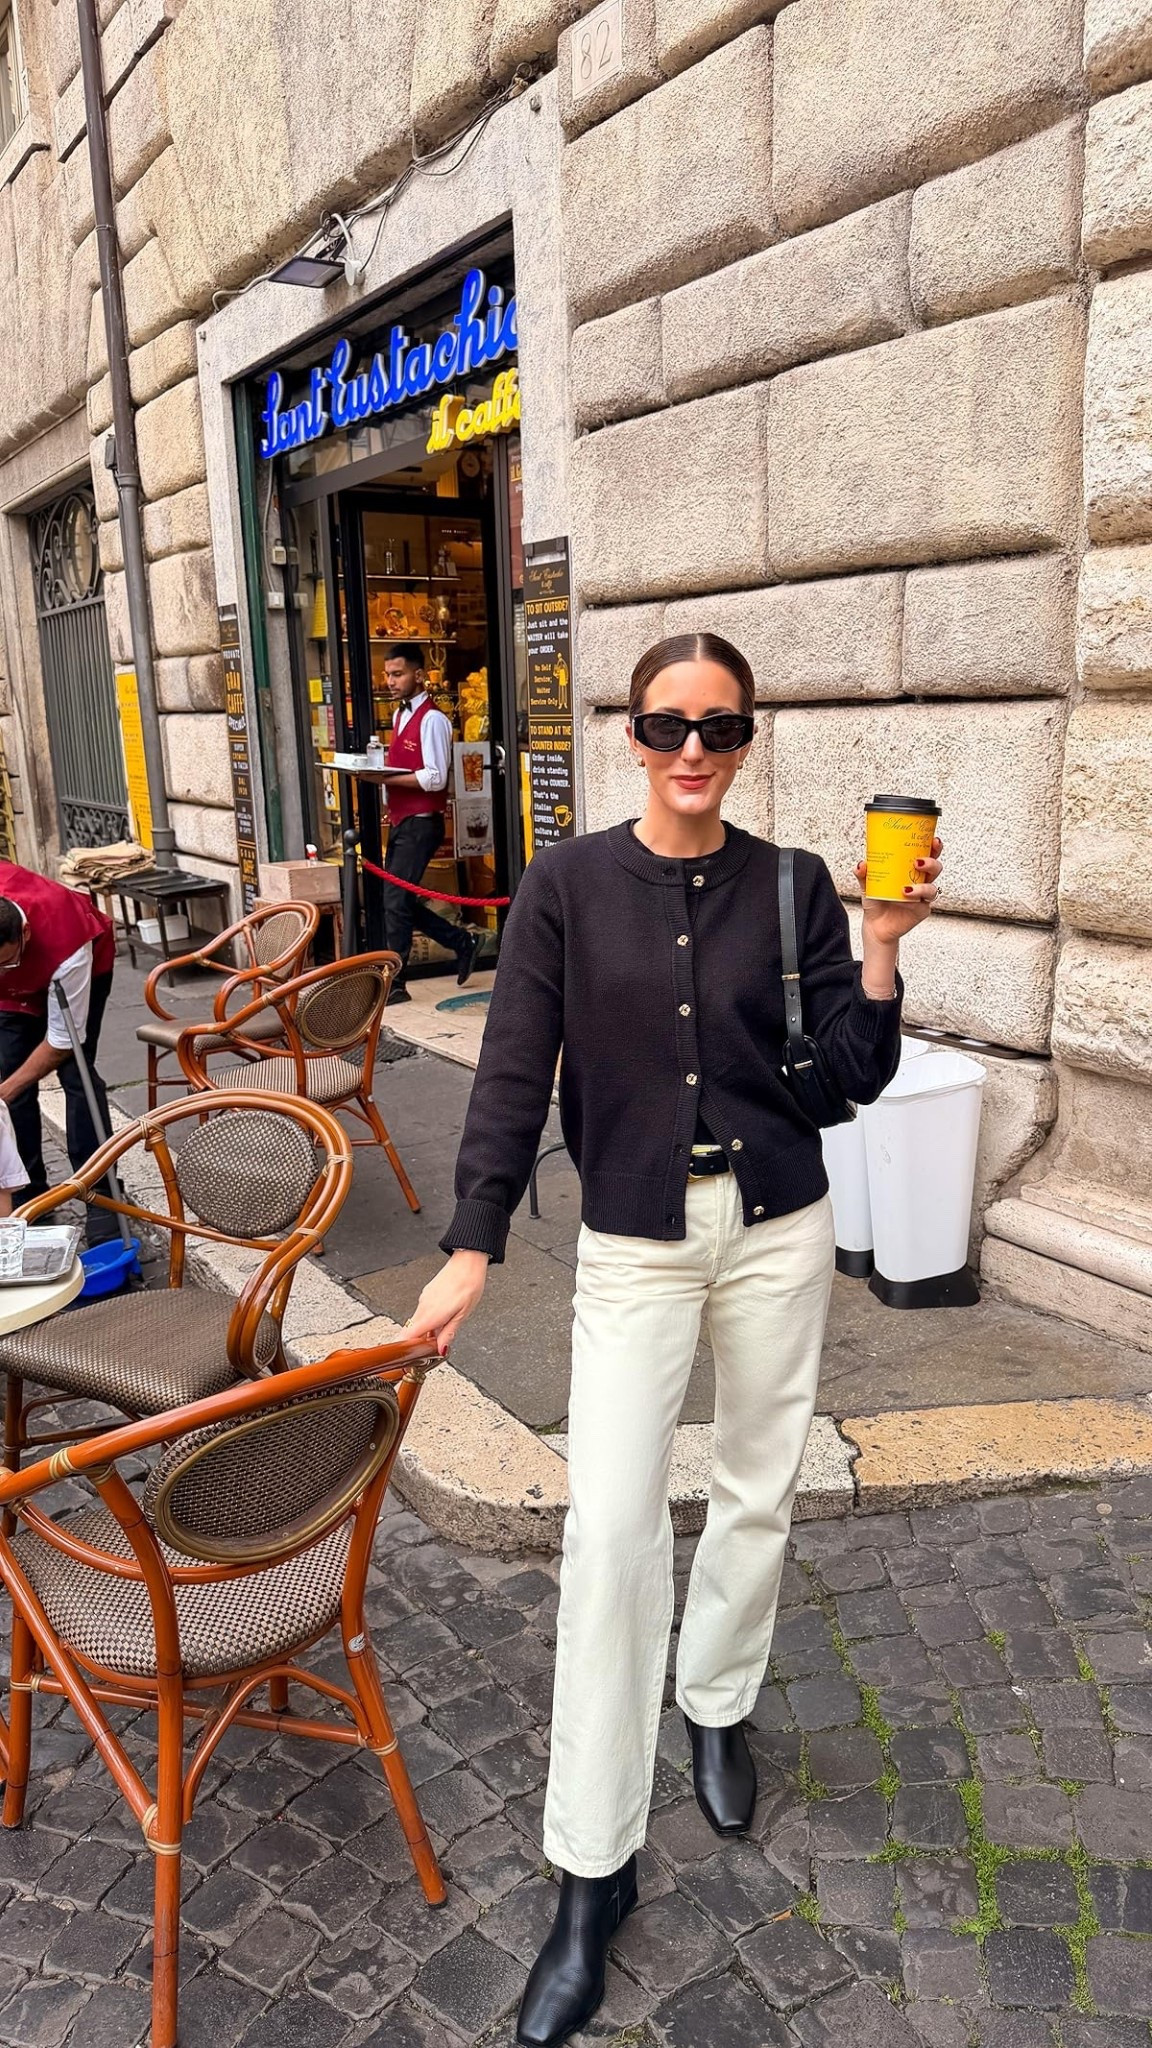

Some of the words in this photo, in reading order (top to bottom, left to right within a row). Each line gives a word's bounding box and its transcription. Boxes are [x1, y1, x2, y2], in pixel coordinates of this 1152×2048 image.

[581, 20, 613, 79] 82
[426, 394, 455, 454] il
[527, 604, 535, 615] TO
[535, 603, 543, 614] SIT
[543, 600, 568, 613] OUTSIDE?
[527, 621, 538, 629] Just
[539, 620, 548, 628] sit
[549, 618, 558, 627] and
[559, 618, 568, 626] the
[544, 632, 555, 641] will
[557, 631, 568, 639] take
[528, 647, 539, 656] your
[539, 645, 555, 654] ORDER.
[530, 698, 547, 706] Service
[547, 698, 558, 707] Only
[530, 725, 537, 735] TO
[537, 725, 554, 736] STAND
[554, 725, 562, 736] AT
[562, 725, 572, 736] THE
[532, 740, 553, 751] COUNTER
[553, 740, 571, 752] INSIDE?
[532, 753, 545, 761] Order
[532, 766, 545, 774] drink
[547, 767, 568, 777] standing
[540, 779, 549, 787] the
[549, 779, 571, 788] COUNTER.
[533, 791, 549, 800] That's
[550, 792, 559, 801] the
[534, 814, 555, 825] ESPRESSO
[534, 828, 553, 836] culture
[553, 829, 560, 837] at
